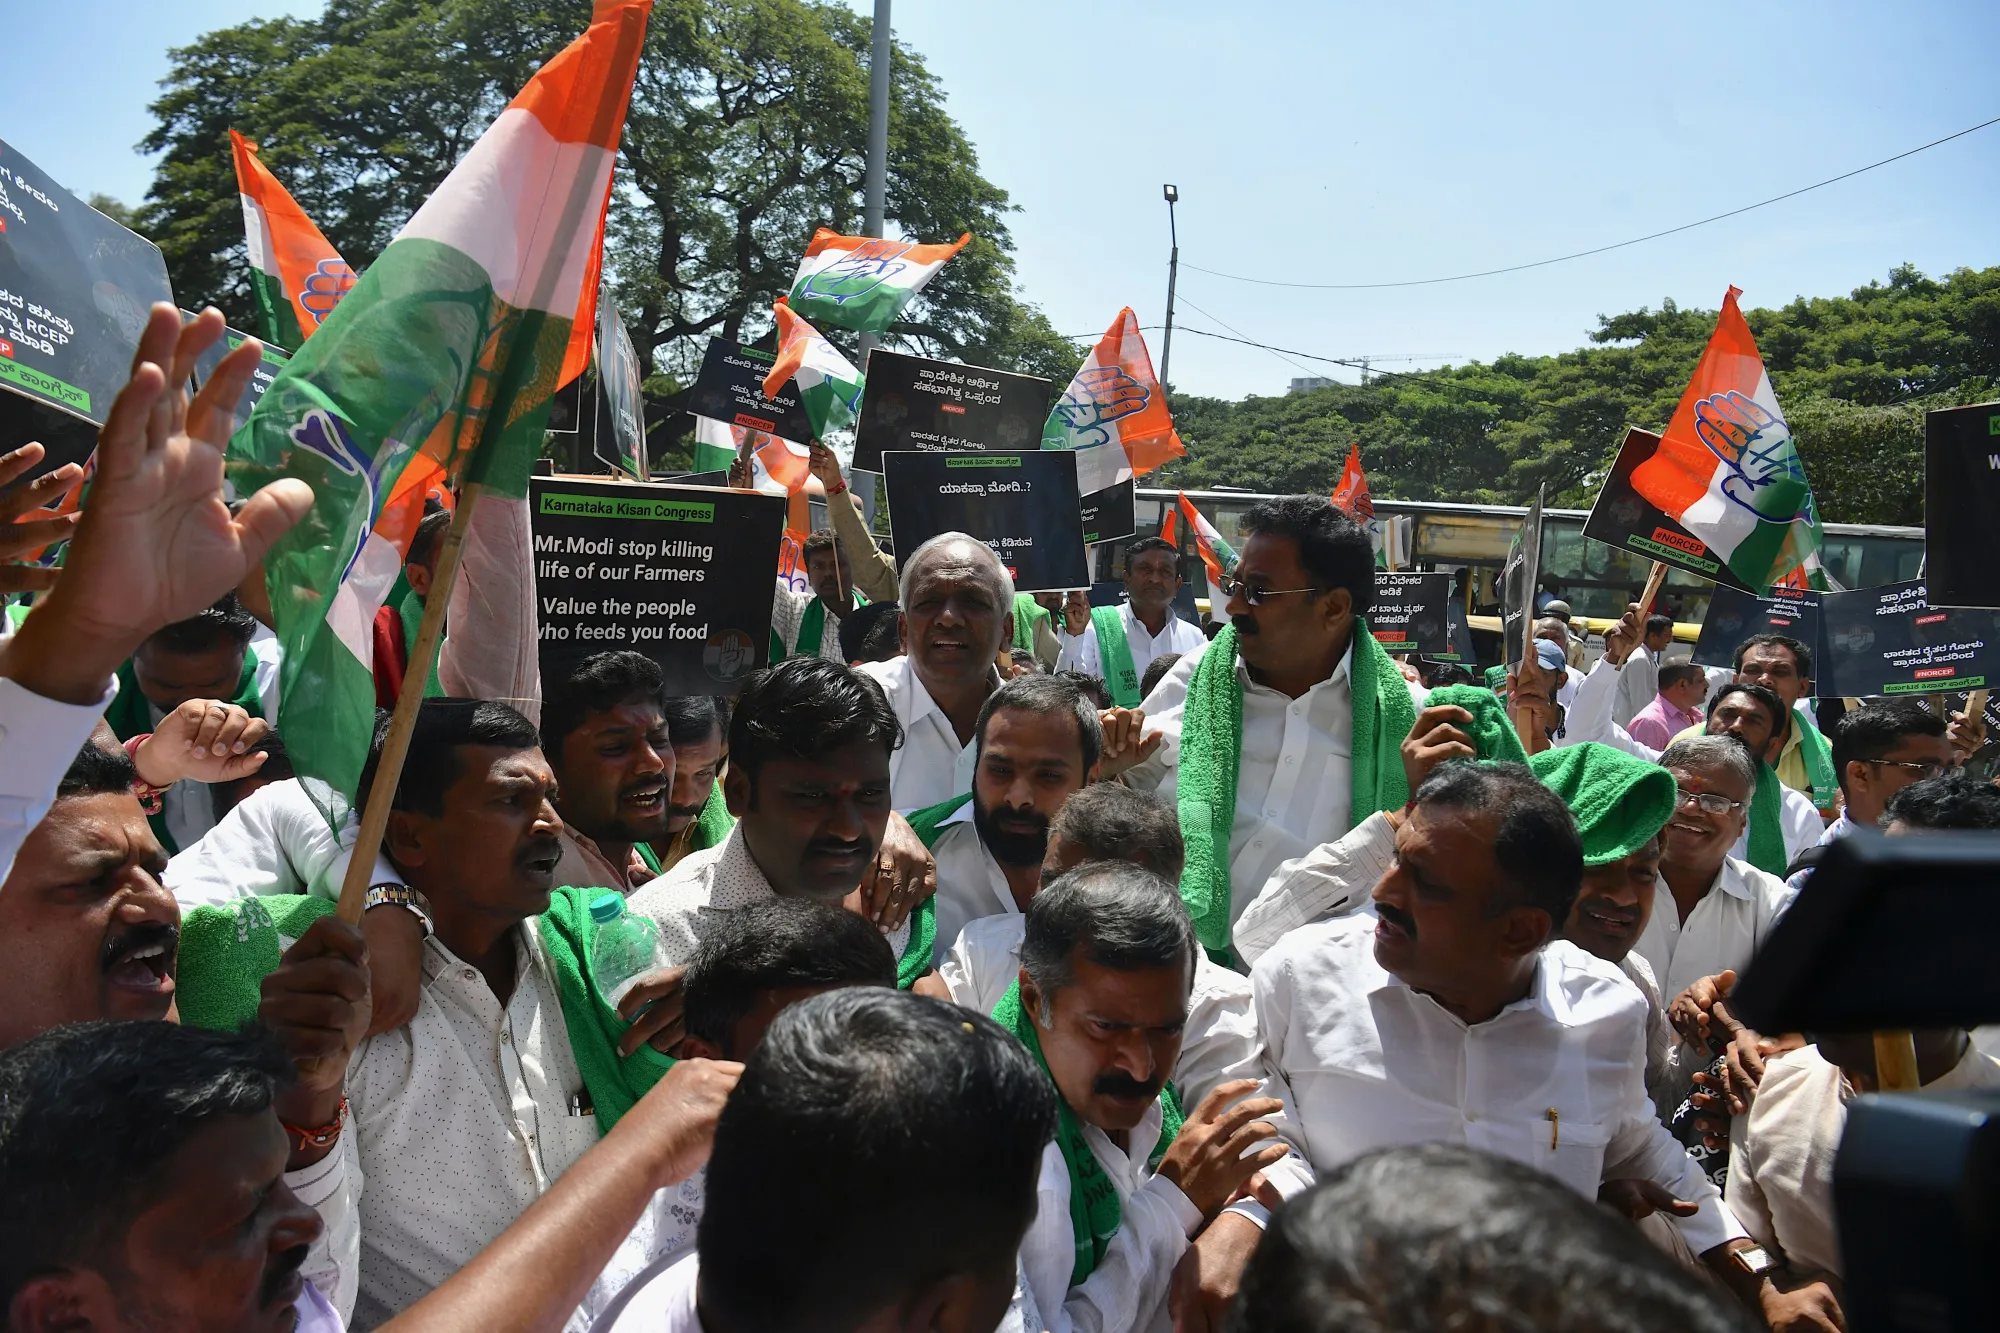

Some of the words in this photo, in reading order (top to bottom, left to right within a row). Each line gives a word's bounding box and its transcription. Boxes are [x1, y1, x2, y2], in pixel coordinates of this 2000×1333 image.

[26, 318, 68, 345] RCEP
[724, 356, 751, 368] ಮೋದಿ
[736, 416, 772, 430] #NORCEP
[544, 498, 613, 514] Karnataka
[616, 502, 650, 516] Kisan
[654, 504, 712, 520] Congress
[534, 534, 614, 556] Mr.Modi
[618, 542, 656, 558] stop
[662, 540, 714, 562] killing
[1656, 532, 1703, 552] #NORCEP
[540, 560, 570, 578] life
[576, 563, 596, 580] of
[600, 566, 629, 580] our
[634, 564, 706, 582] Farmers
[1880, 586, 1927, 604] ಪ್ರಾದೇಶಿ
[543, 597, 596, 615] Value
[602, 598, 632, 616] the
[636, 599, 696, 619] people
[575, 623, 626, 640] feeds
[631, 627, 662, 644] you
[668, 624, 708, 640] food
[1917, 668, 1953, 677] #NORCEP
